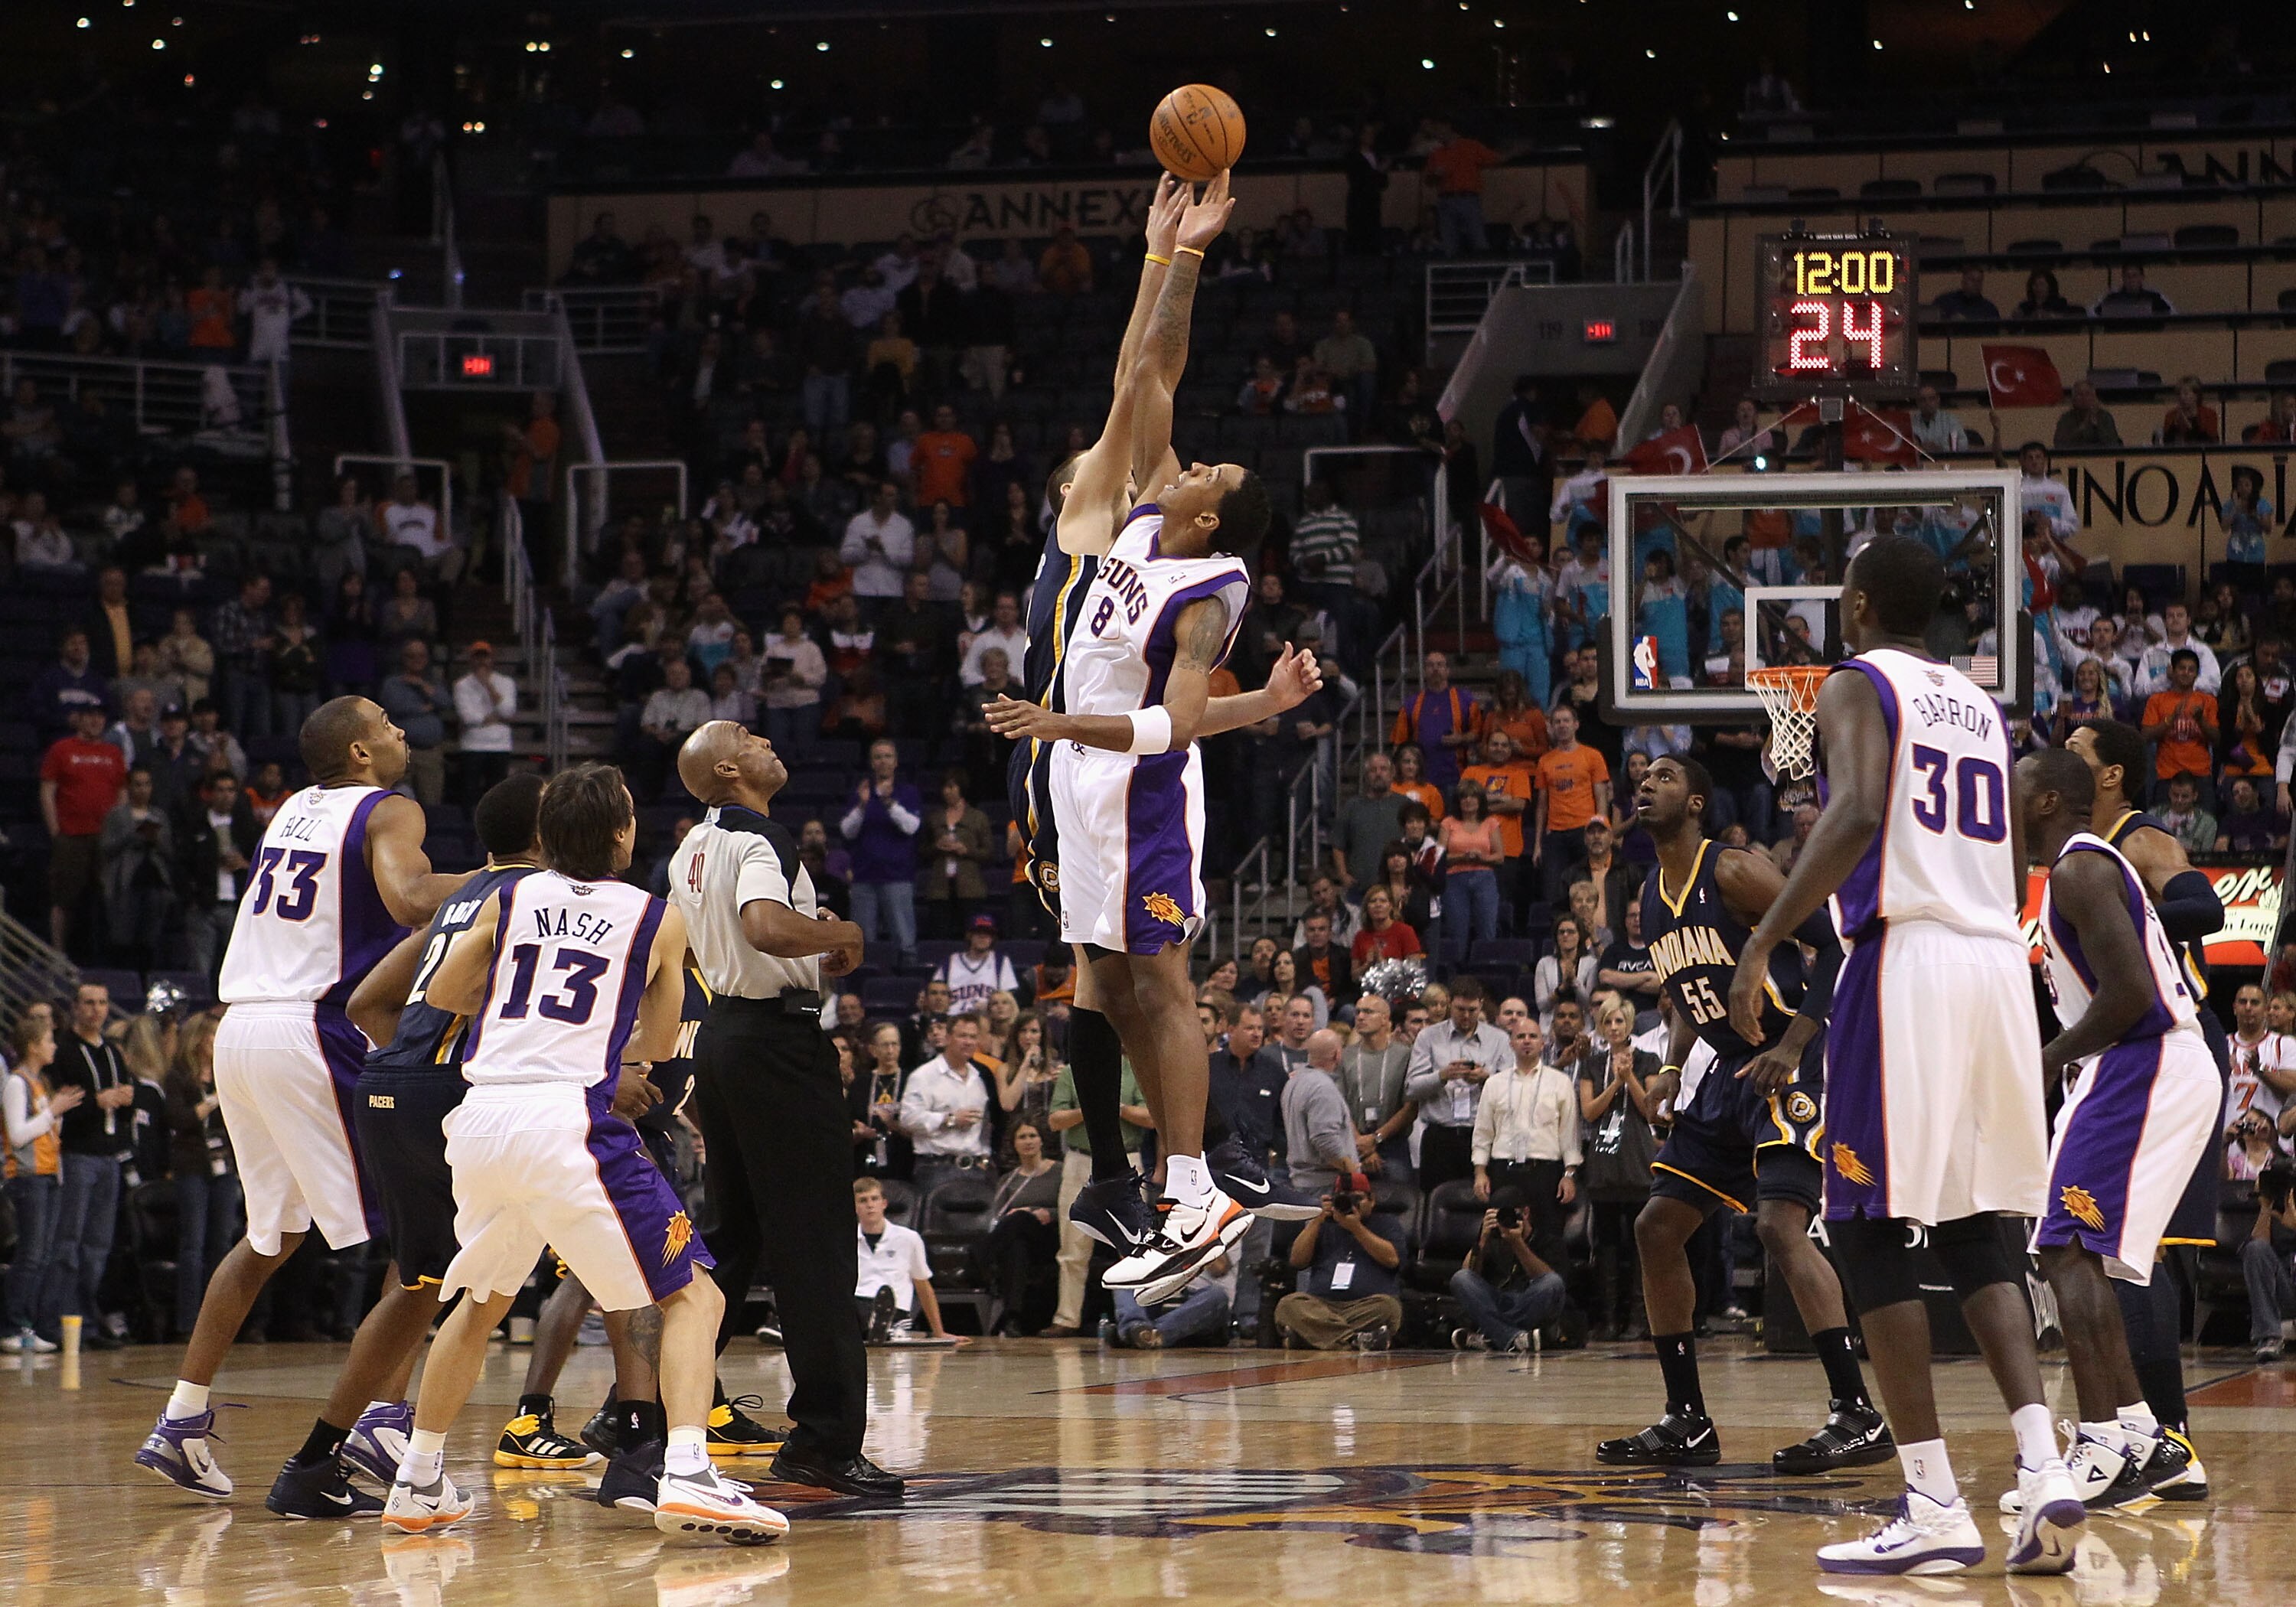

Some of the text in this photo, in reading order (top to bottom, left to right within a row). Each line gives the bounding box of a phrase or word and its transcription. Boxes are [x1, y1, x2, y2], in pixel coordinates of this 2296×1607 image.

[1794, 251, 1893, 294] 12:00
[1791, 301, 1881, 368] 24
[1097, 556, 1149, 627] SUNS
[1090, 595, 1115, 638] 8
[1637, 677, 1654, 687] NBA
[1913, 693, 1991, 742] BARRON
[1910, 741, 2007, 846] 30
[279, 816, 321, 843] HILL
[252, 846, 329, 923] 33
[687, 852, 706, 894] 40
[533, 907, 614, 946] NASH
[1617, 960, 1653, 972] RVCA
[1649, 925, 1737, 985] INDIANA
[498, 943, 612, 1027] 13
[1680, 976, 1727, 1025] 55
[369, 1094, 395, 1110] PACERS
[2234, 1081, 2258, 1111] 7
